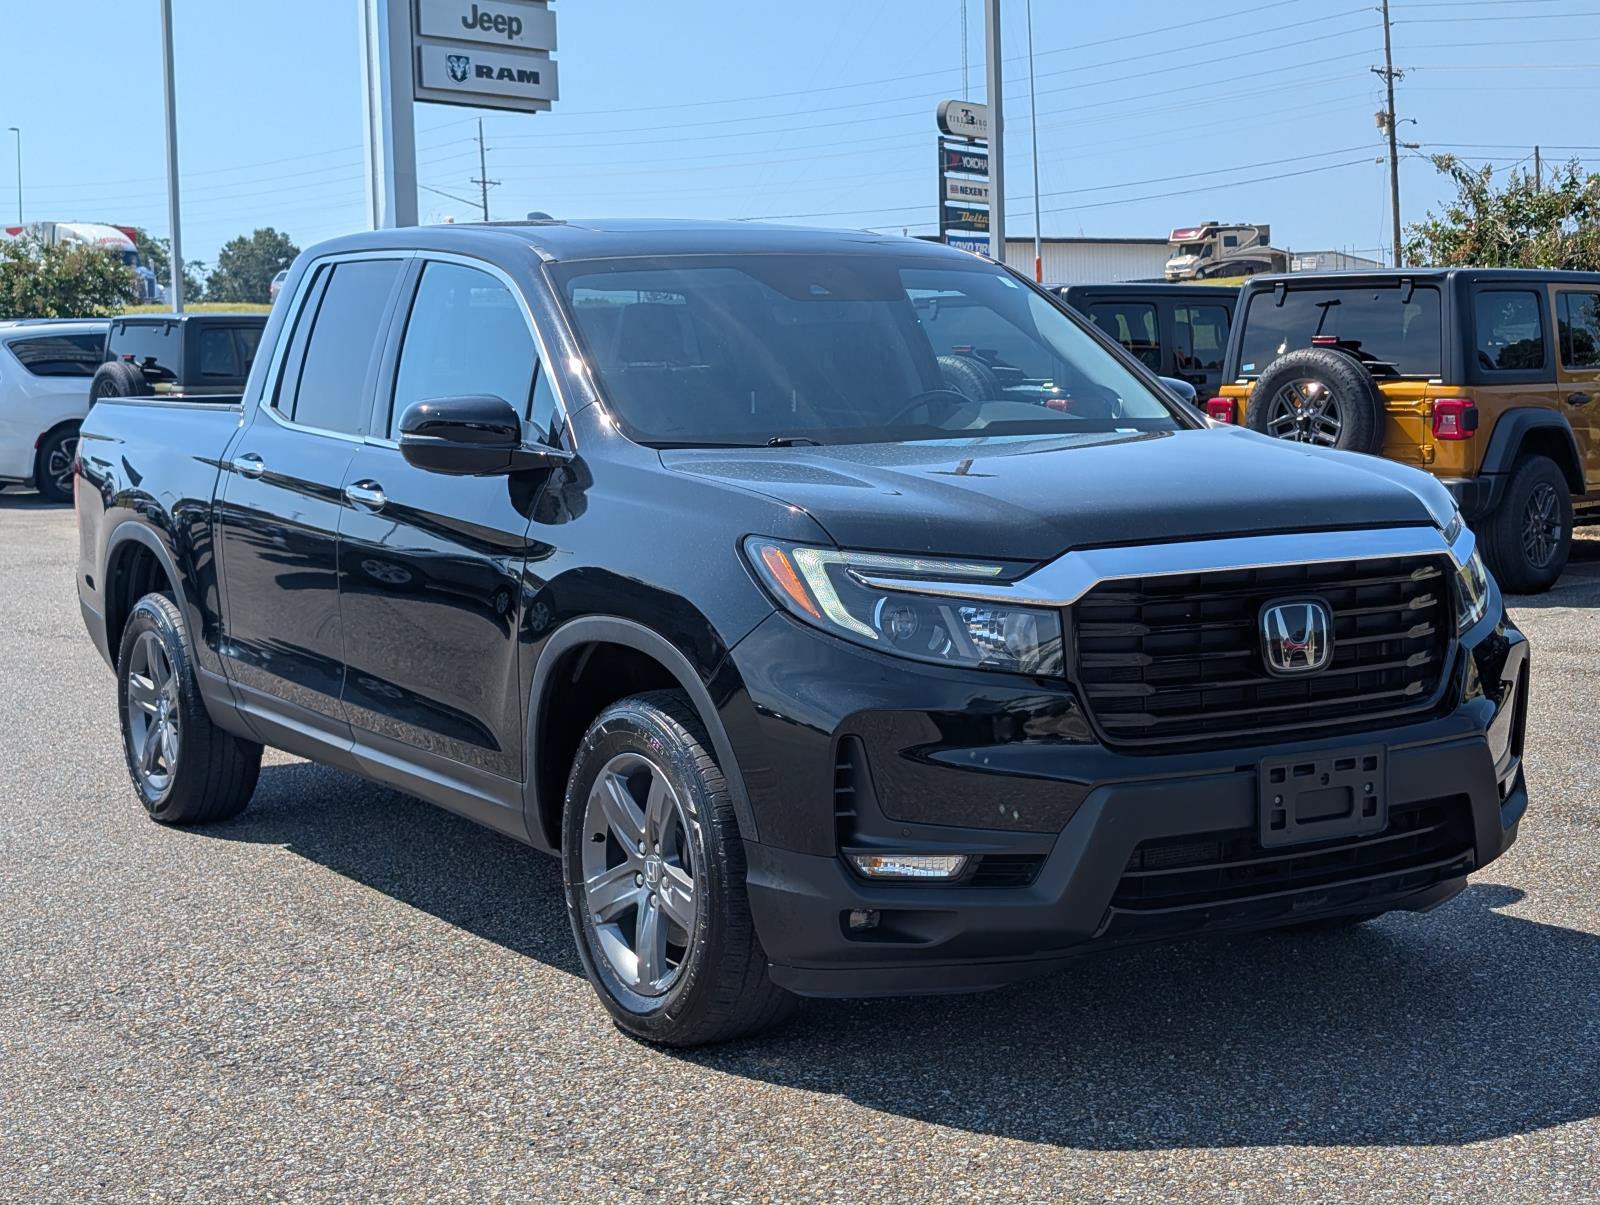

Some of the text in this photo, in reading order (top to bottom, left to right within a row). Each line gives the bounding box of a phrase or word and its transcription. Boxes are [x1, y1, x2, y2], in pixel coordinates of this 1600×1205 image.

[461, 4, 522, 40] Jeep
[475, 64, 540, 85] RAM
[960, 185, 982, 196] NEXEN
[957, 210, 988, 224] Delta
